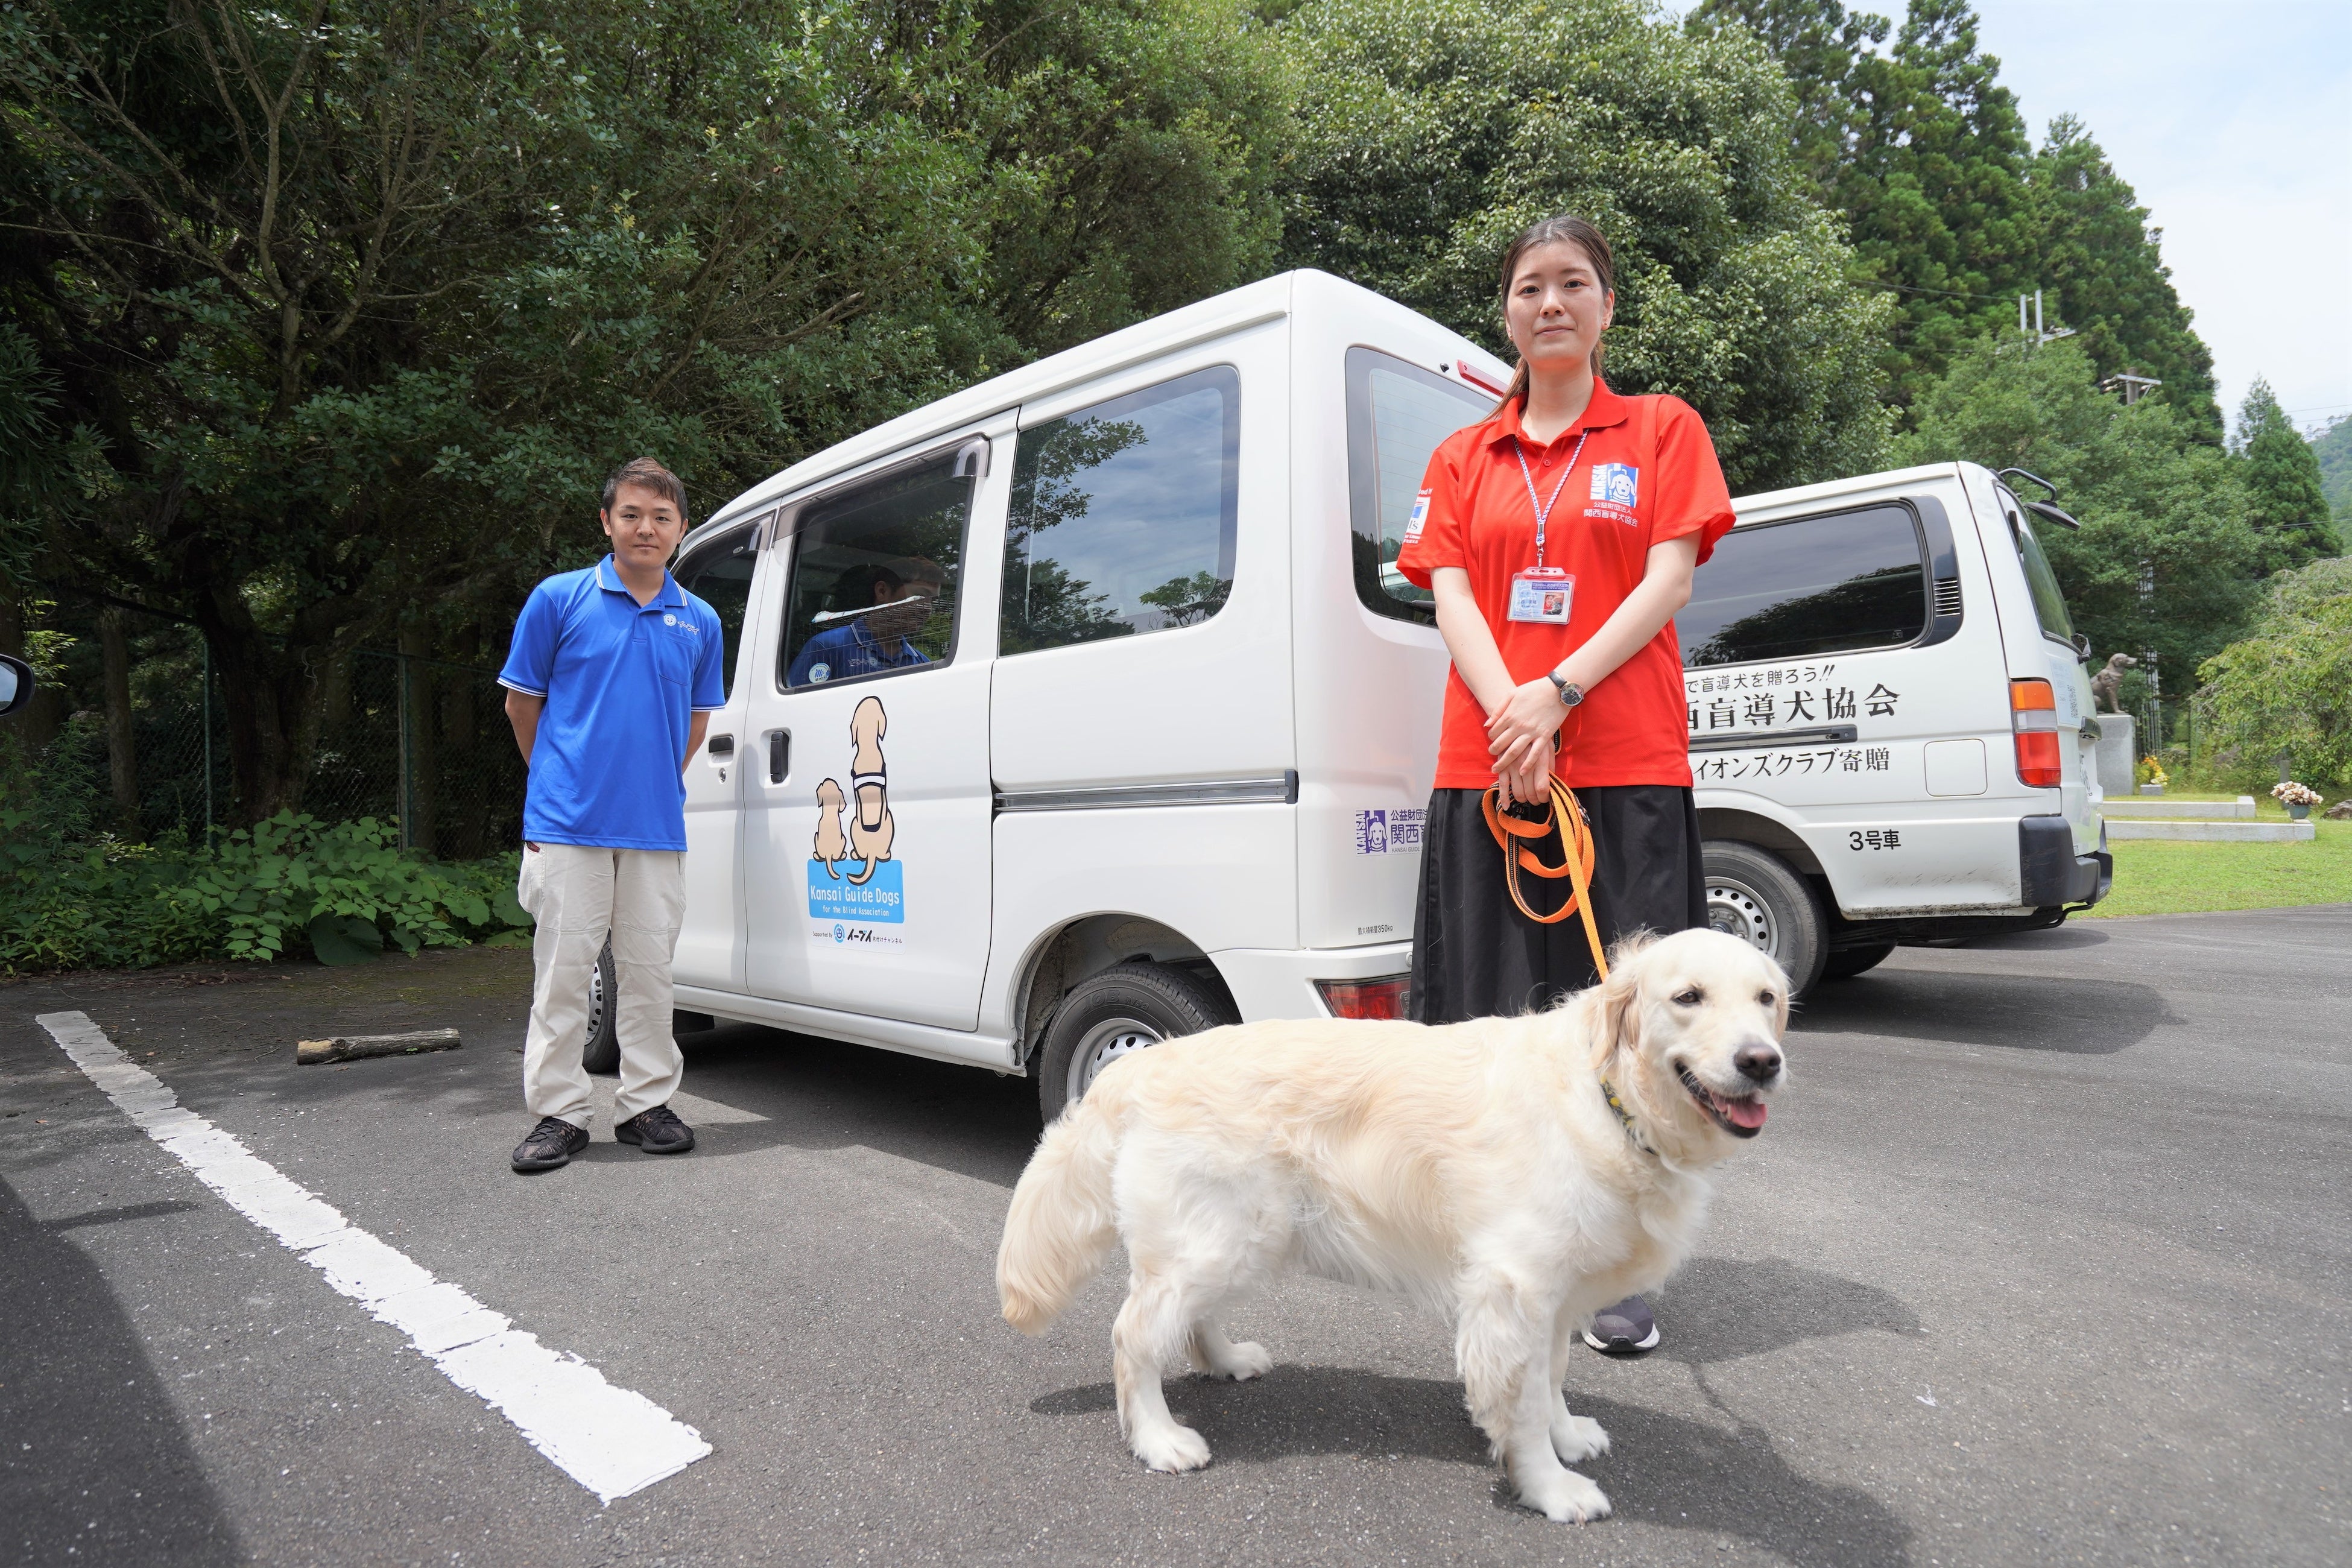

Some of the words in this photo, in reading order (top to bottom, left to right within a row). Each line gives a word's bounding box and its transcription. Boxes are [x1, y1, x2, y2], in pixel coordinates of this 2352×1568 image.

[1584, 508, 1638, 527] 関西盲導犬協会
[1593, 501, 1632, 515] 公益財団法人
[1693, 747, 1890, 780] イオンズクラブ寄贈
[1391, 824, 1424, 844] 関西
[1849, 829, 1902, 851] 3号車
[811, 885, 842, 902] Kansai
[845, 886, 873, 903] Guide
[876, 888, 900, 906] Dogs
[842, 906, 856, 914] Blind
[858, 907, 890, 917] Association
[847, 928, 873, 943] イーブイ
[1081, 990, 1121, 1014] JOB
